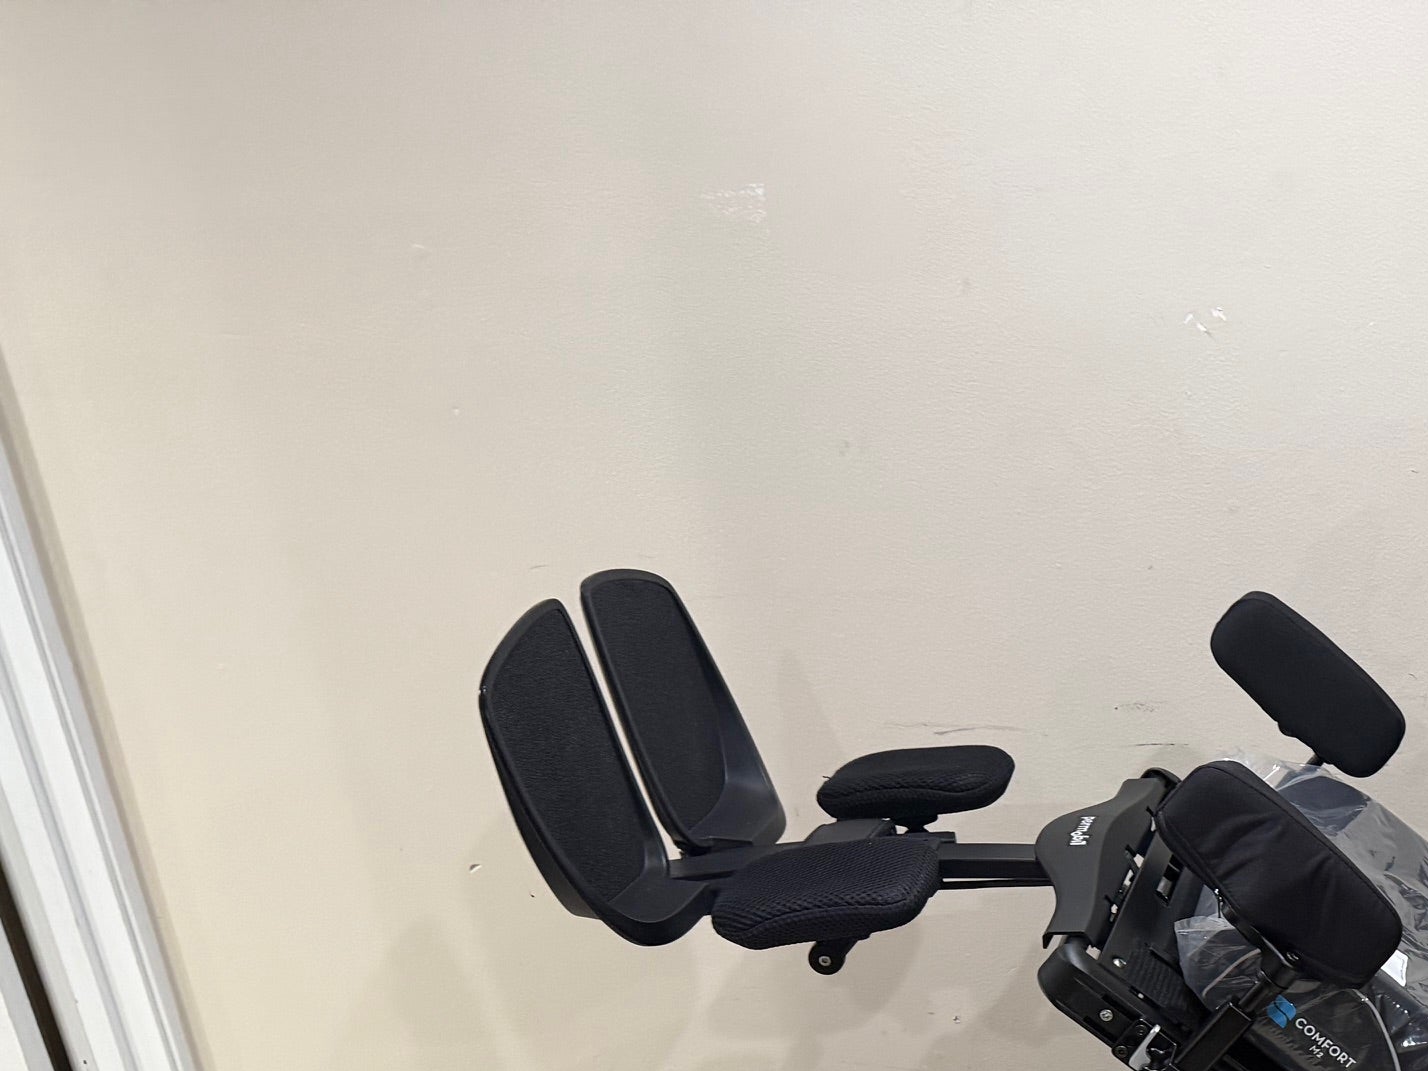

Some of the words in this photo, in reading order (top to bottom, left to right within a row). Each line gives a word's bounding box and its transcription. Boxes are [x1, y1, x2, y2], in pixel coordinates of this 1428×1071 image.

[1069, 816, 1096, 846] permobil
[1295, 1018, 1357, 1068] COMFORT
[1308, 1045, 1324, 1058] M2
